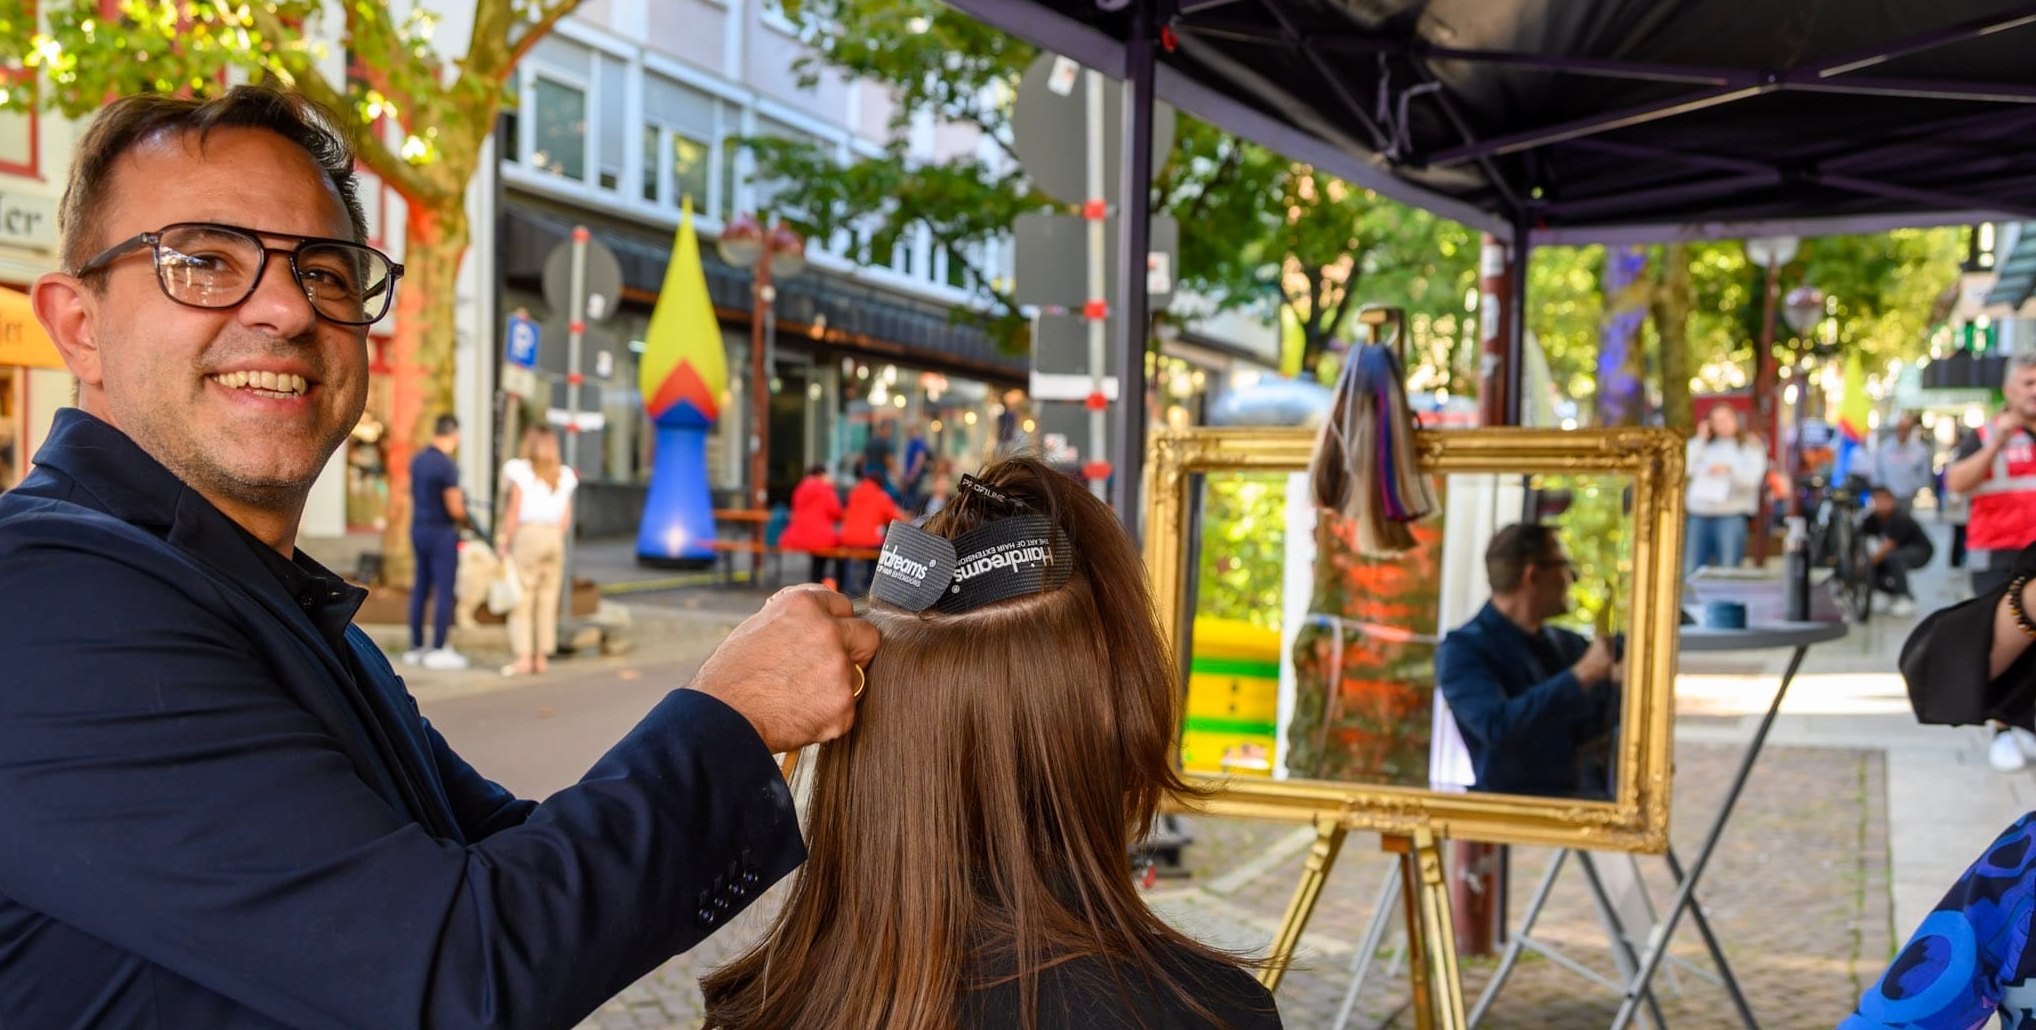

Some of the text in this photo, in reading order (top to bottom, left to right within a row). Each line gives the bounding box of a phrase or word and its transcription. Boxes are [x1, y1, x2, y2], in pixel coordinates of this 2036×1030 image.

[0, 190, 42, 237] er
[511, 322, 536, 359] P
[997, 542, 1015, 553] HAIR
[1017, 540, 1026, 548] OF
[952, 546, 1054, 583] Hairdreams
